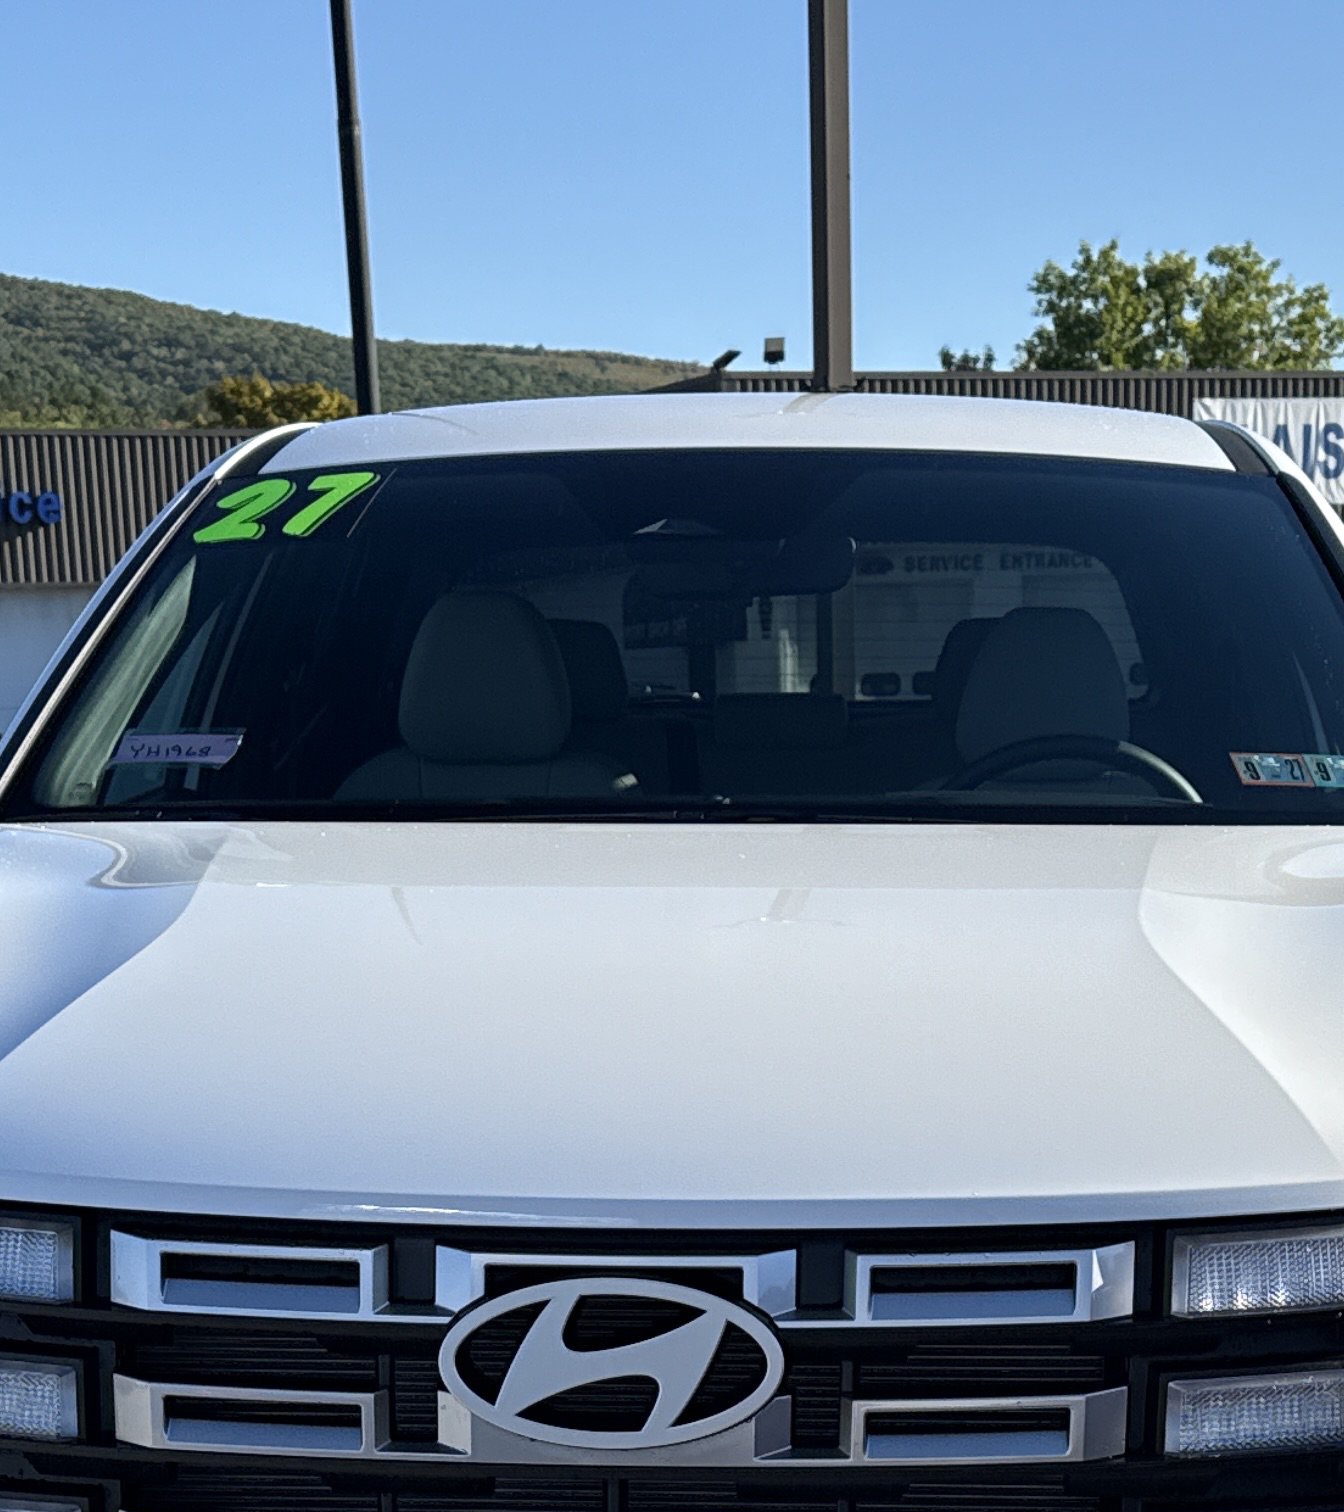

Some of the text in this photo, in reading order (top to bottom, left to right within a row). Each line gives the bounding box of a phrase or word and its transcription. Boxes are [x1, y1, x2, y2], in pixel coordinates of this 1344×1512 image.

[192, 471, 382, 544] 27
[903, 551, 1093, 574] SERVICE ENTRANCE
[1243, 758, 1305, 783] 9 27
[1316, 761, 1332, 782] 9
